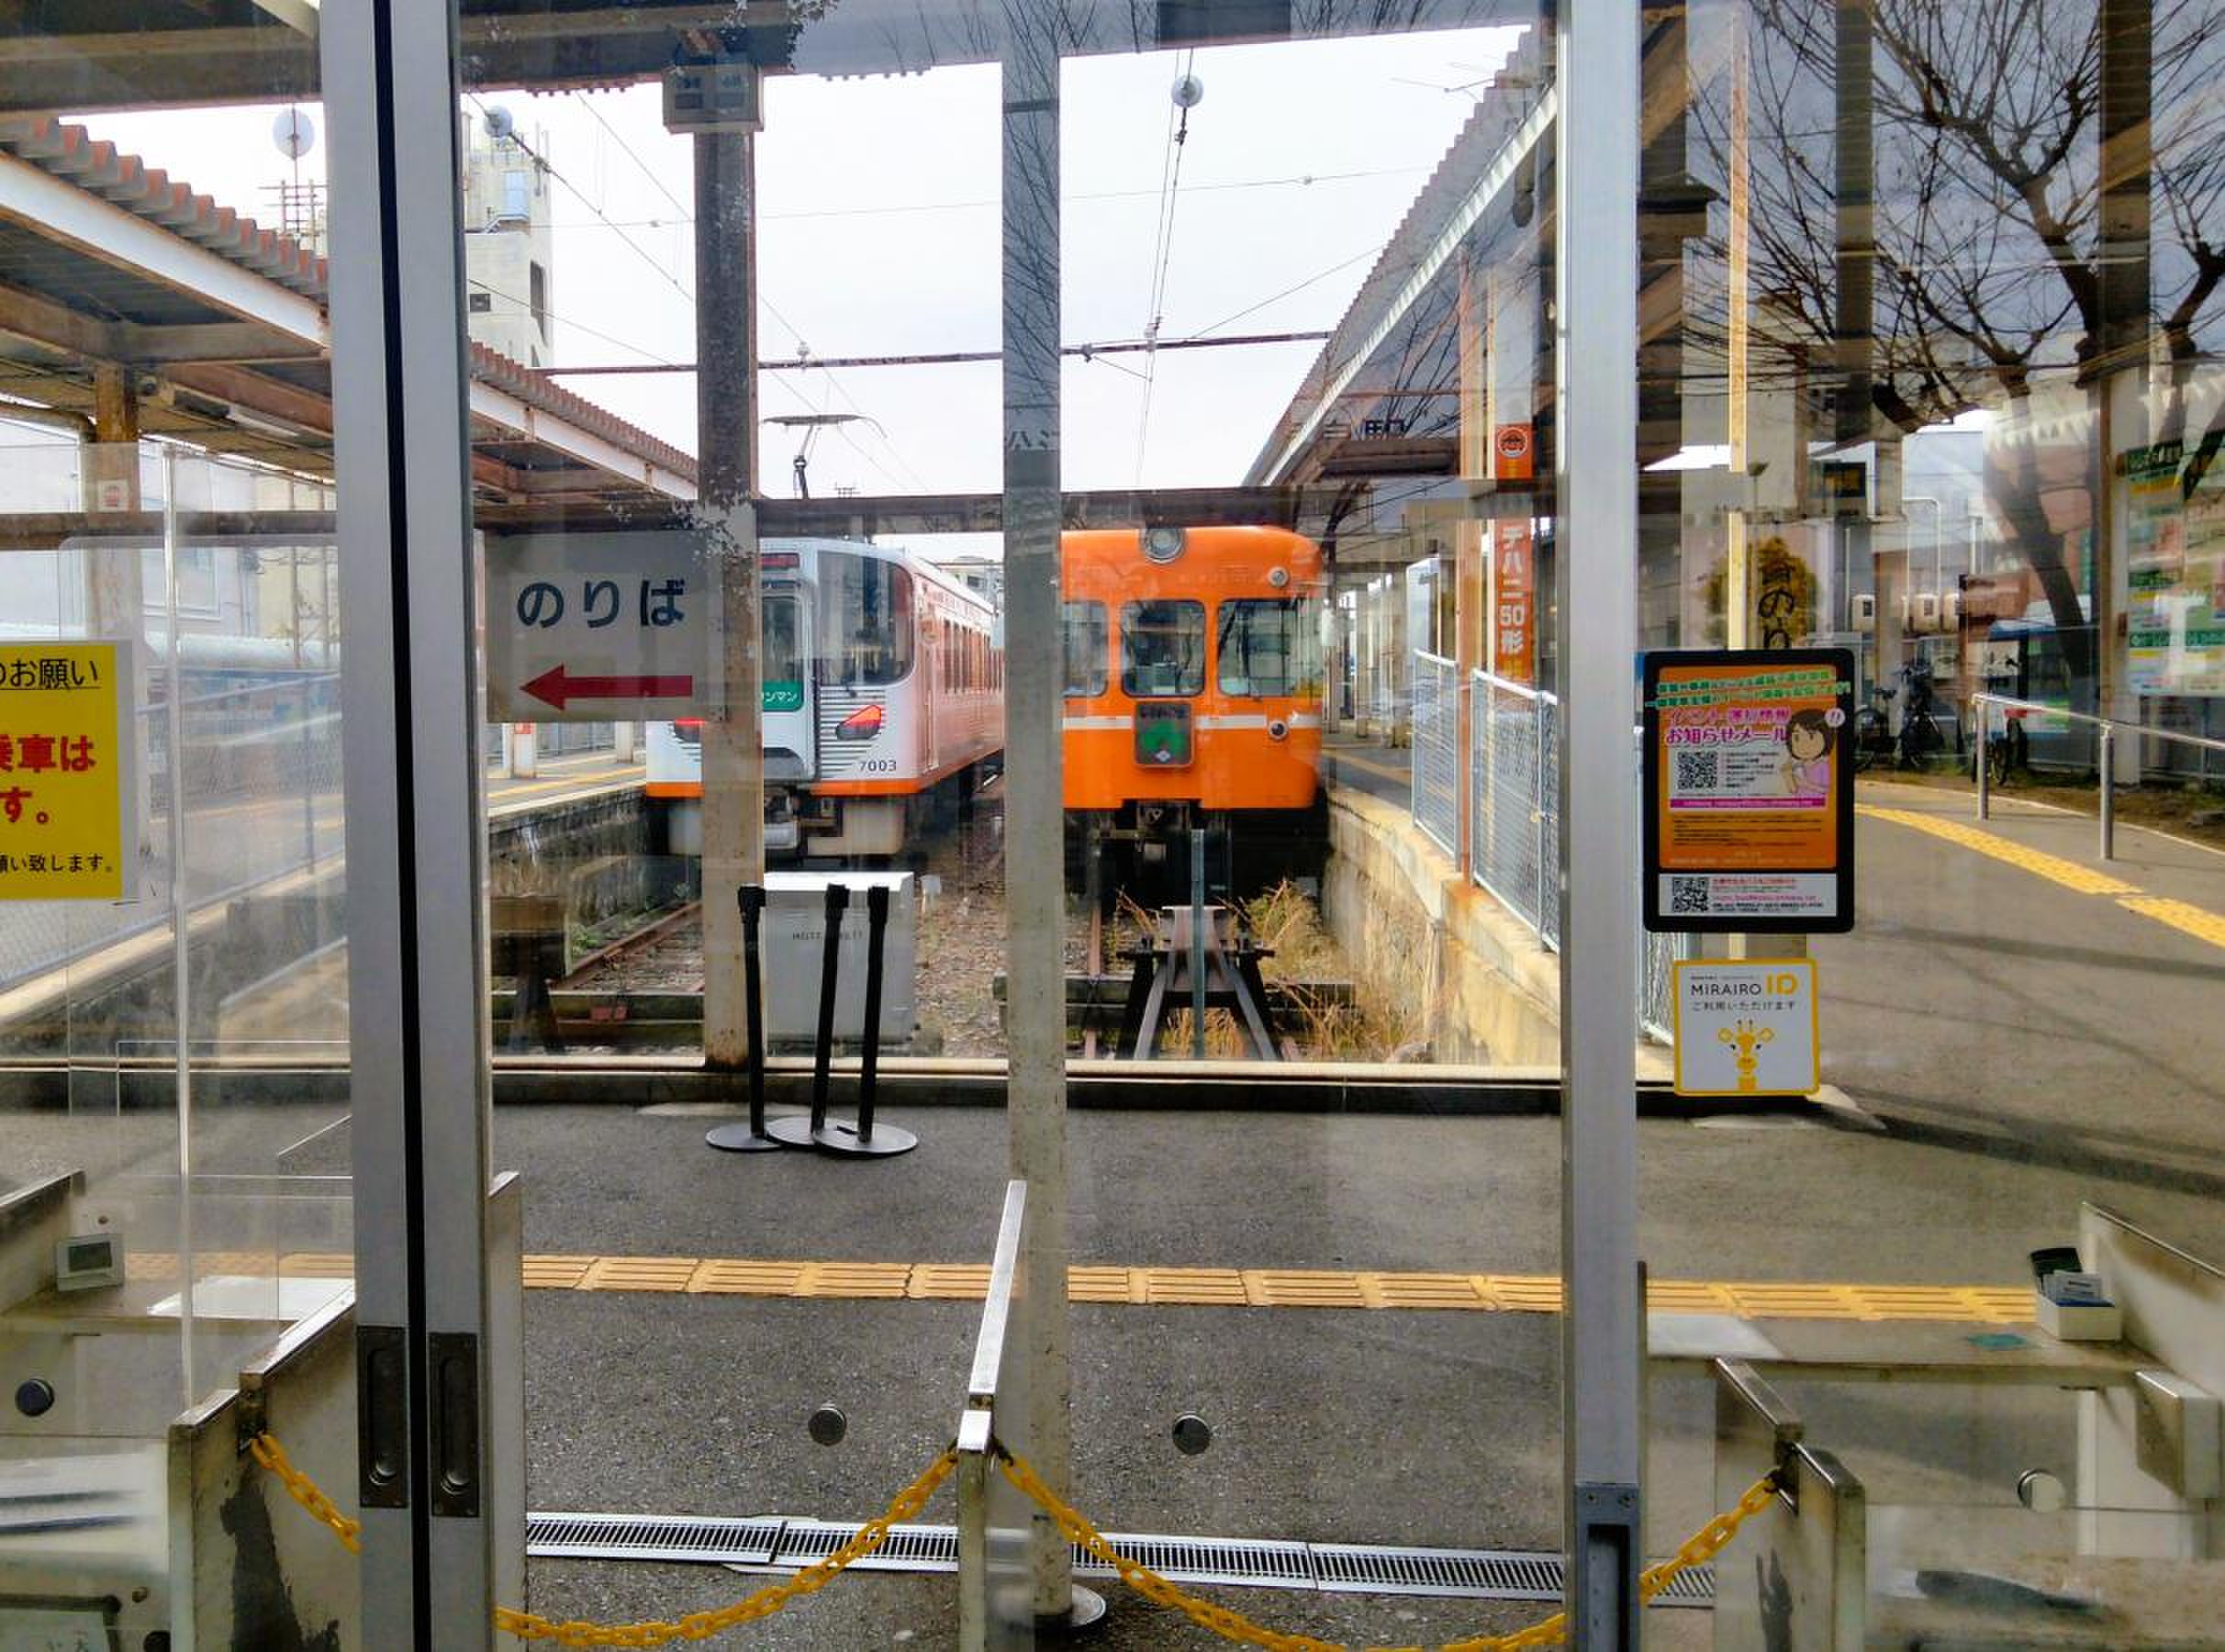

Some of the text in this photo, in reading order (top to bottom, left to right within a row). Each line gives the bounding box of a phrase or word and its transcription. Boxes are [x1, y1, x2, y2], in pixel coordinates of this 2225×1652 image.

[517, 579, 685, 628] のりば
[0, 657, 98, 690] お願い
[763, 690, 798, 703] ンマン
[1666, 726, 1791, 746] お知らせメール
[859, 760, 897, 772] 7003
[1690, 972, 1798, 997] MIRAIRO ID
